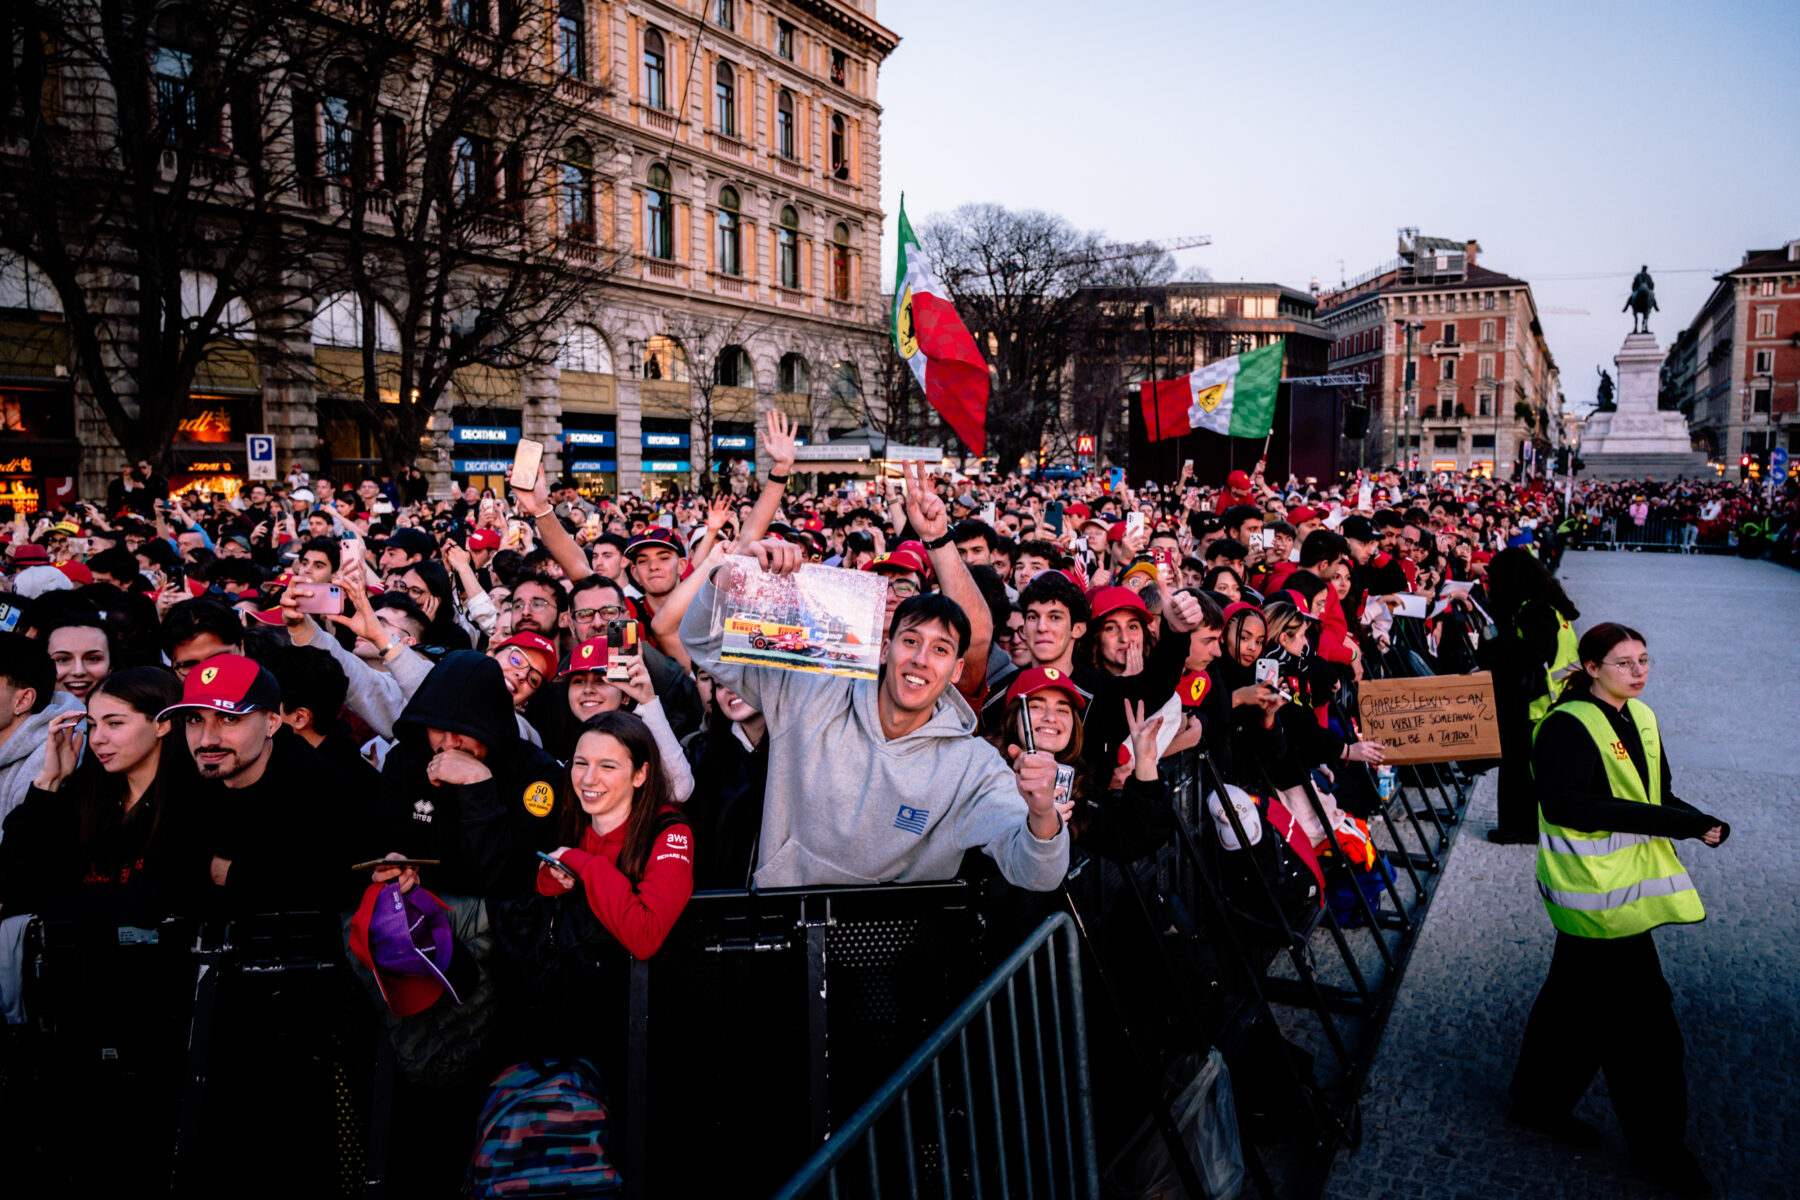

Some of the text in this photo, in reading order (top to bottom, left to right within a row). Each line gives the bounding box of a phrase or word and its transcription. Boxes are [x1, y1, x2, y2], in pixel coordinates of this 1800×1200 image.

[461, 429, 507, 441] DECATHLON
[570, 433, 603, 443] ECATHLON
[255, 439, 269, 459] P
[1079, 439, 1093, 452] M
[465, 461, 508, 472] DECATHLON
[213, 699, 235, 709] 16
[1456, 692, 1484, 705] CAN
[1366, 717, 1385, 735] YOU
[1391, 714, 1425, 730] WRITE
[1382, 736, 1407, 748] WILL
[1407, 733, 1421, 744] BE
[1428, 733, 1435, 743] A
[535, 785, 548, 795] 50
[667, 833, 688, 845] aws
